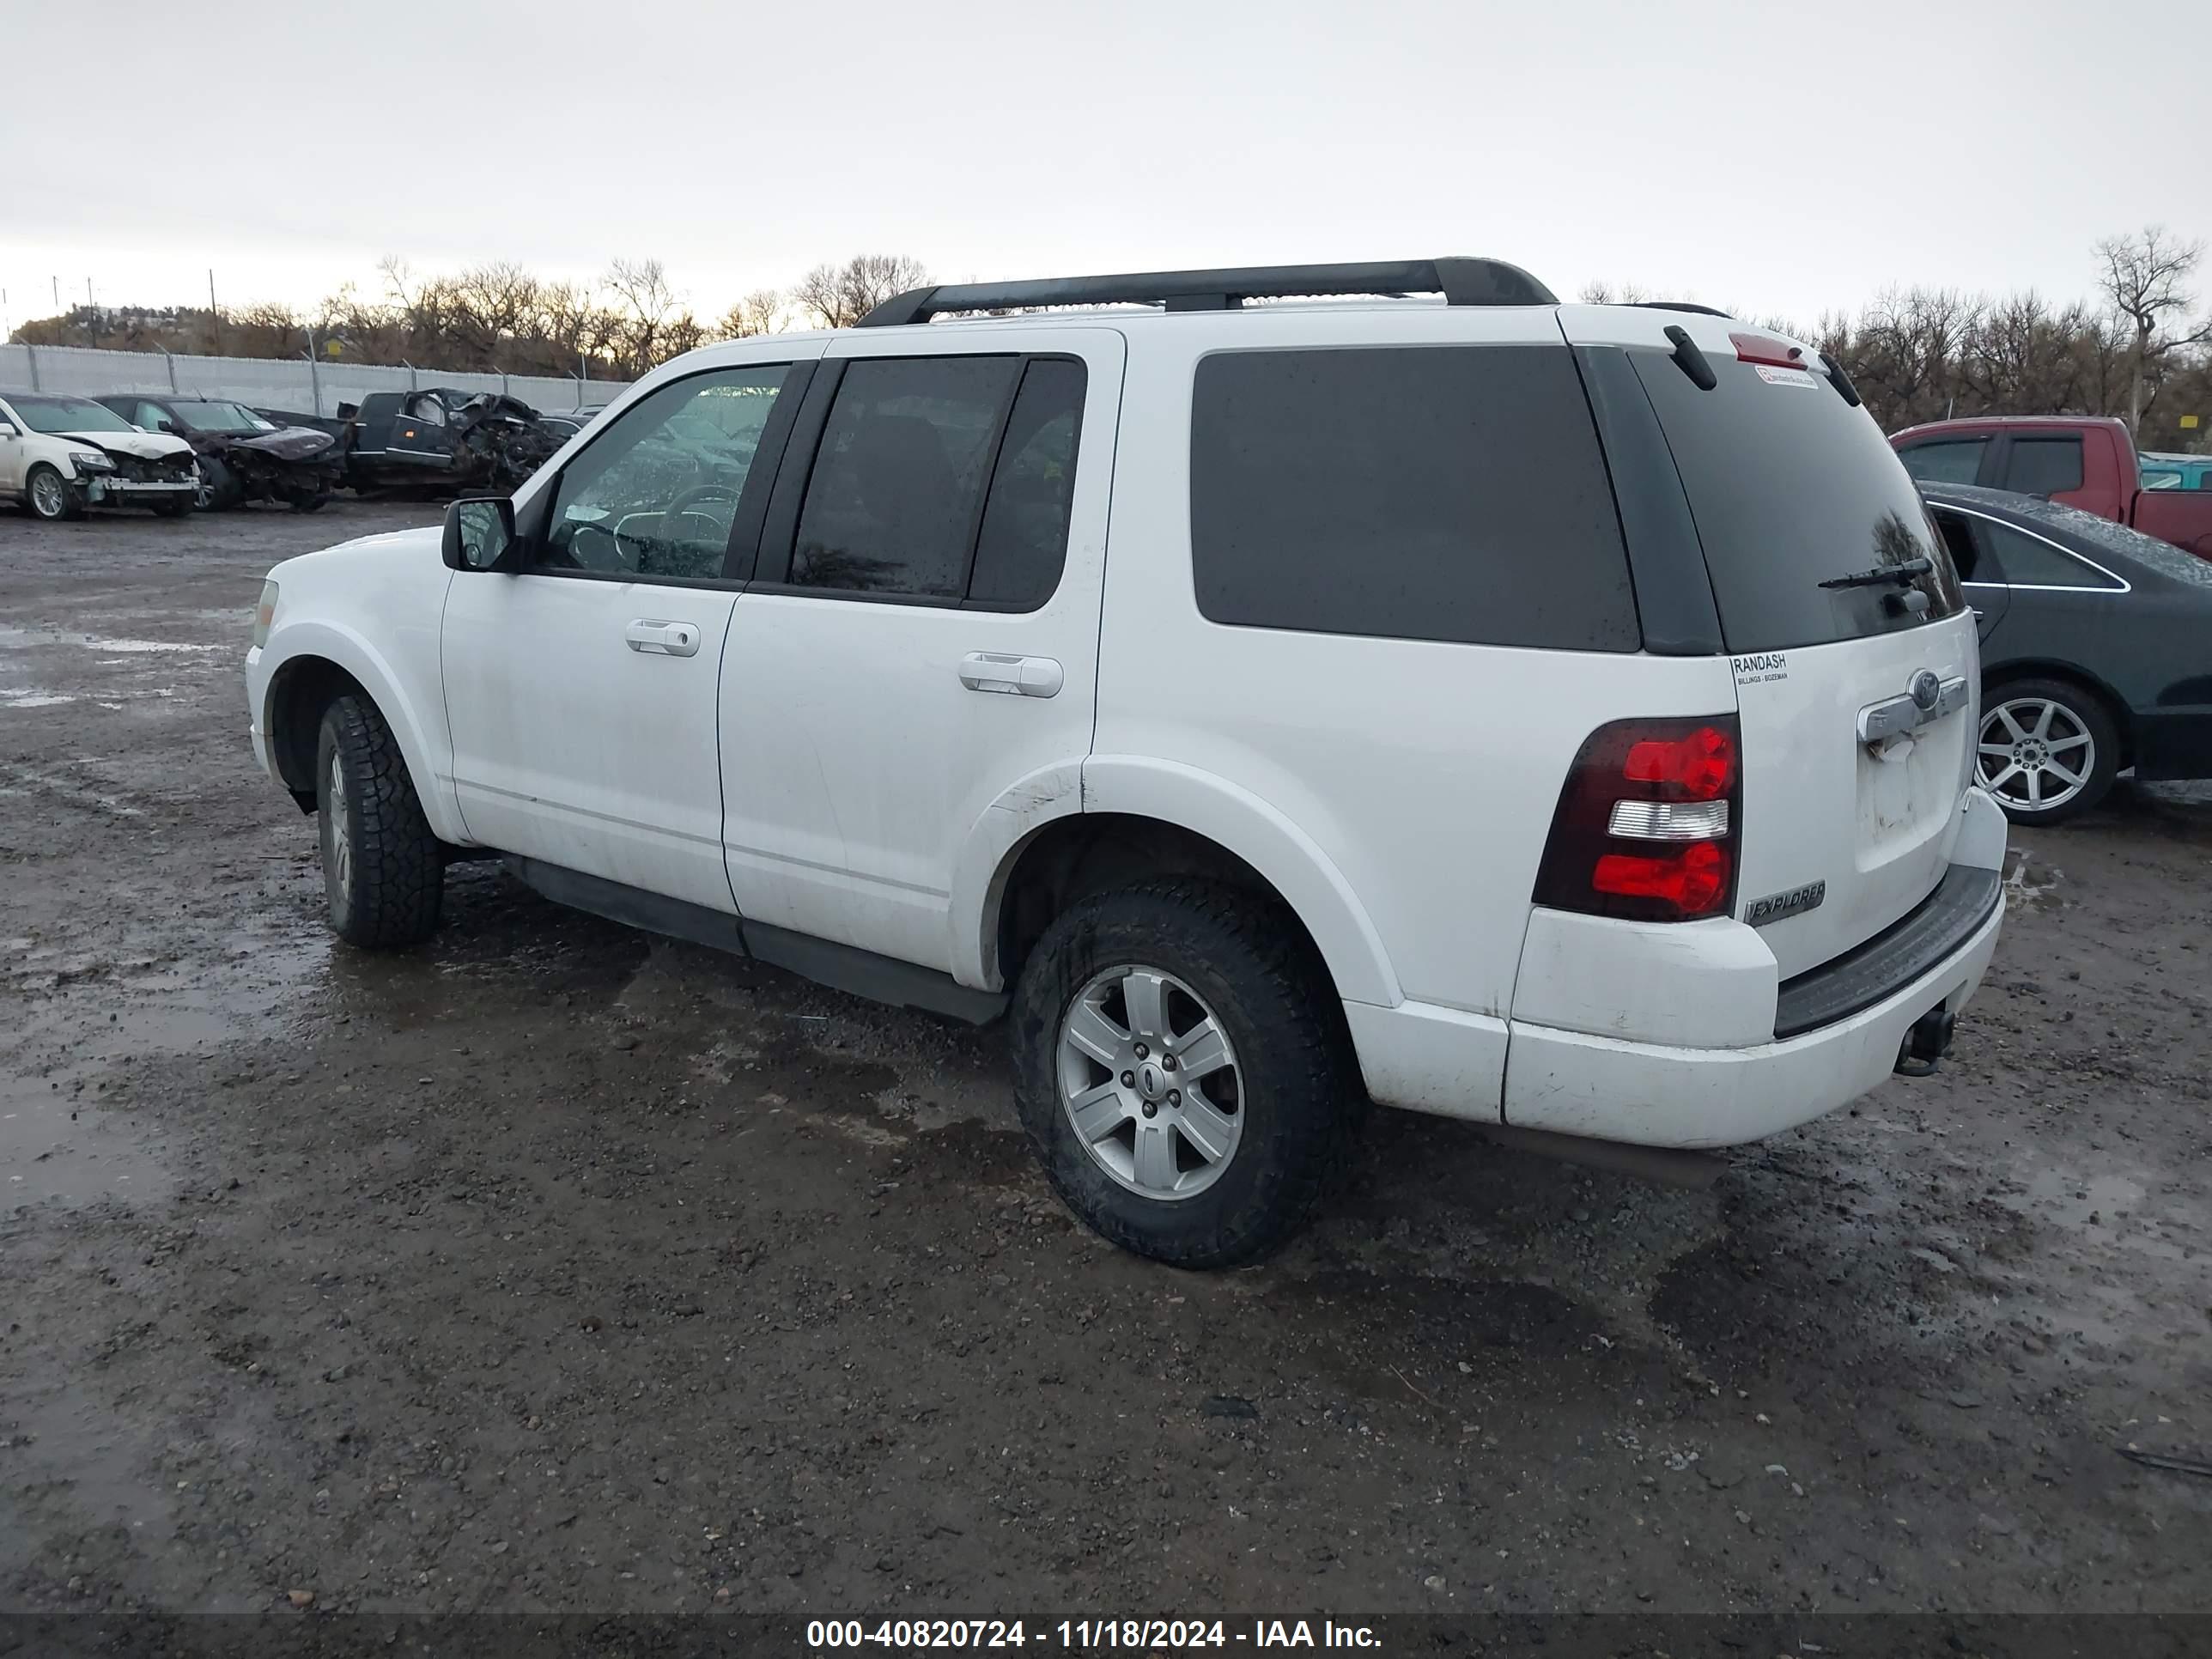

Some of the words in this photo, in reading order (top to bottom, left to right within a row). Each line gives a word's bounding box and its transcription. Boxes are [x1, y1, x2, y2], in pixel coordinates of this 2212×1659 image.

[1734, 653, 1786, 673] RANDASH
[1738, 676, 1761, 685] BILLINGS
[1765, 673, 1788, 682] BOZEMAN
[1751, 884, 1825, 919] EXPLORER
